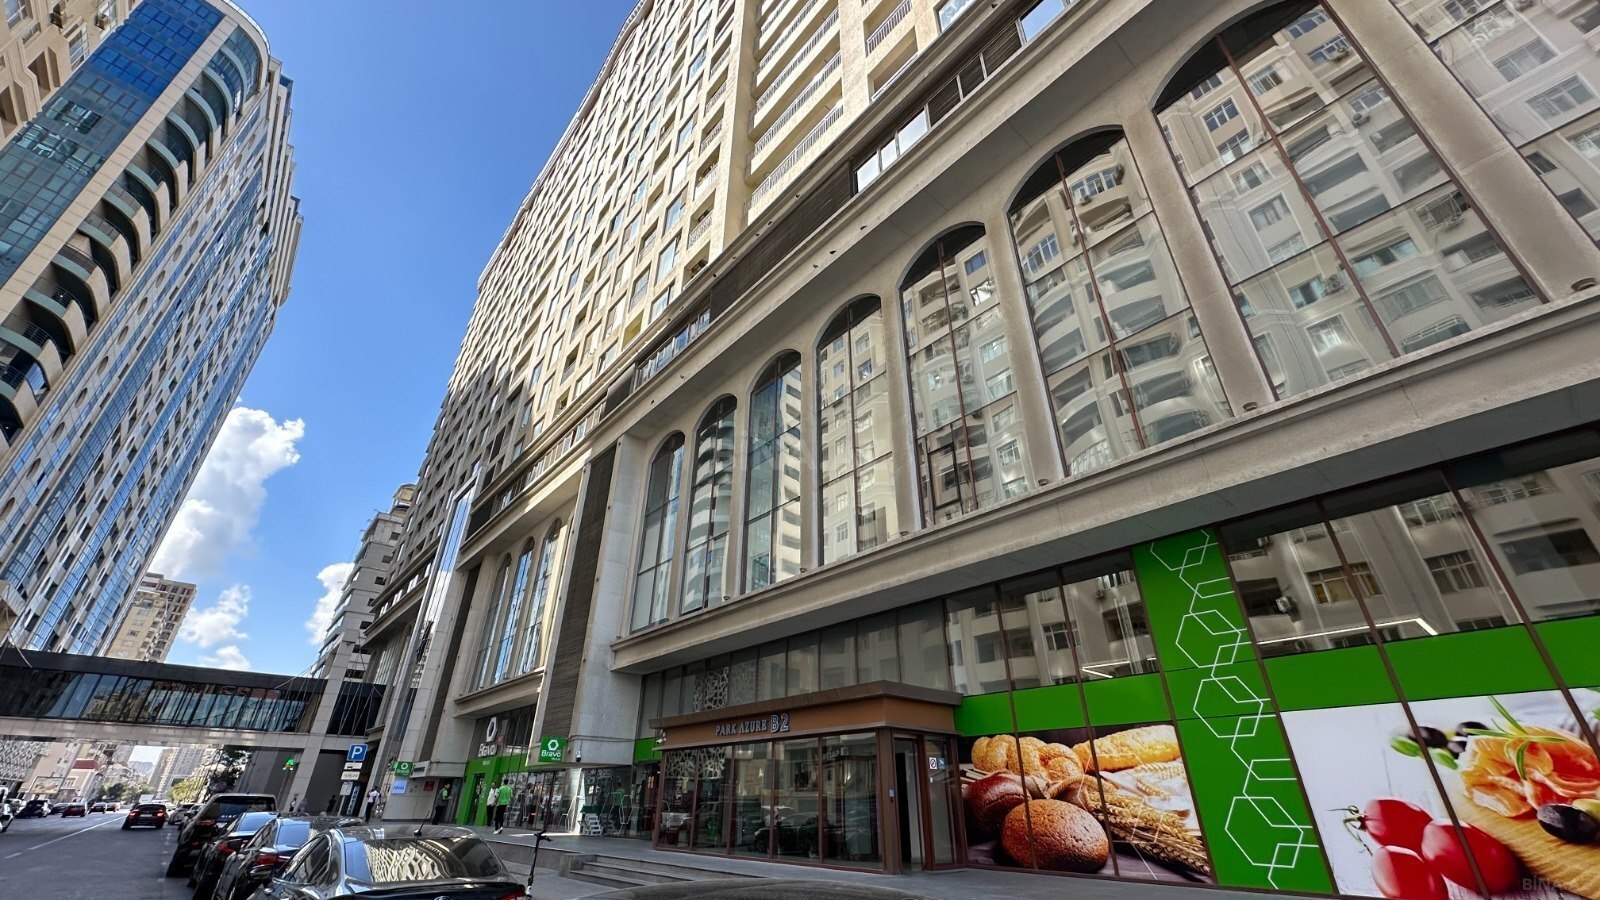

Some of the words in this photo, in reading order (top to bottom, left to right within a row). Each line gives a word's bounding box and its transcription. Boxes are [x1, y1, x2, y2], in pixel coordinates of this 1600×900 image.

[715, 723, 737, 736] PARK
[738, 719, 767, 734] AZURE
[770, 713, 789, 733] B2
[351, 746, 363, 759] P
